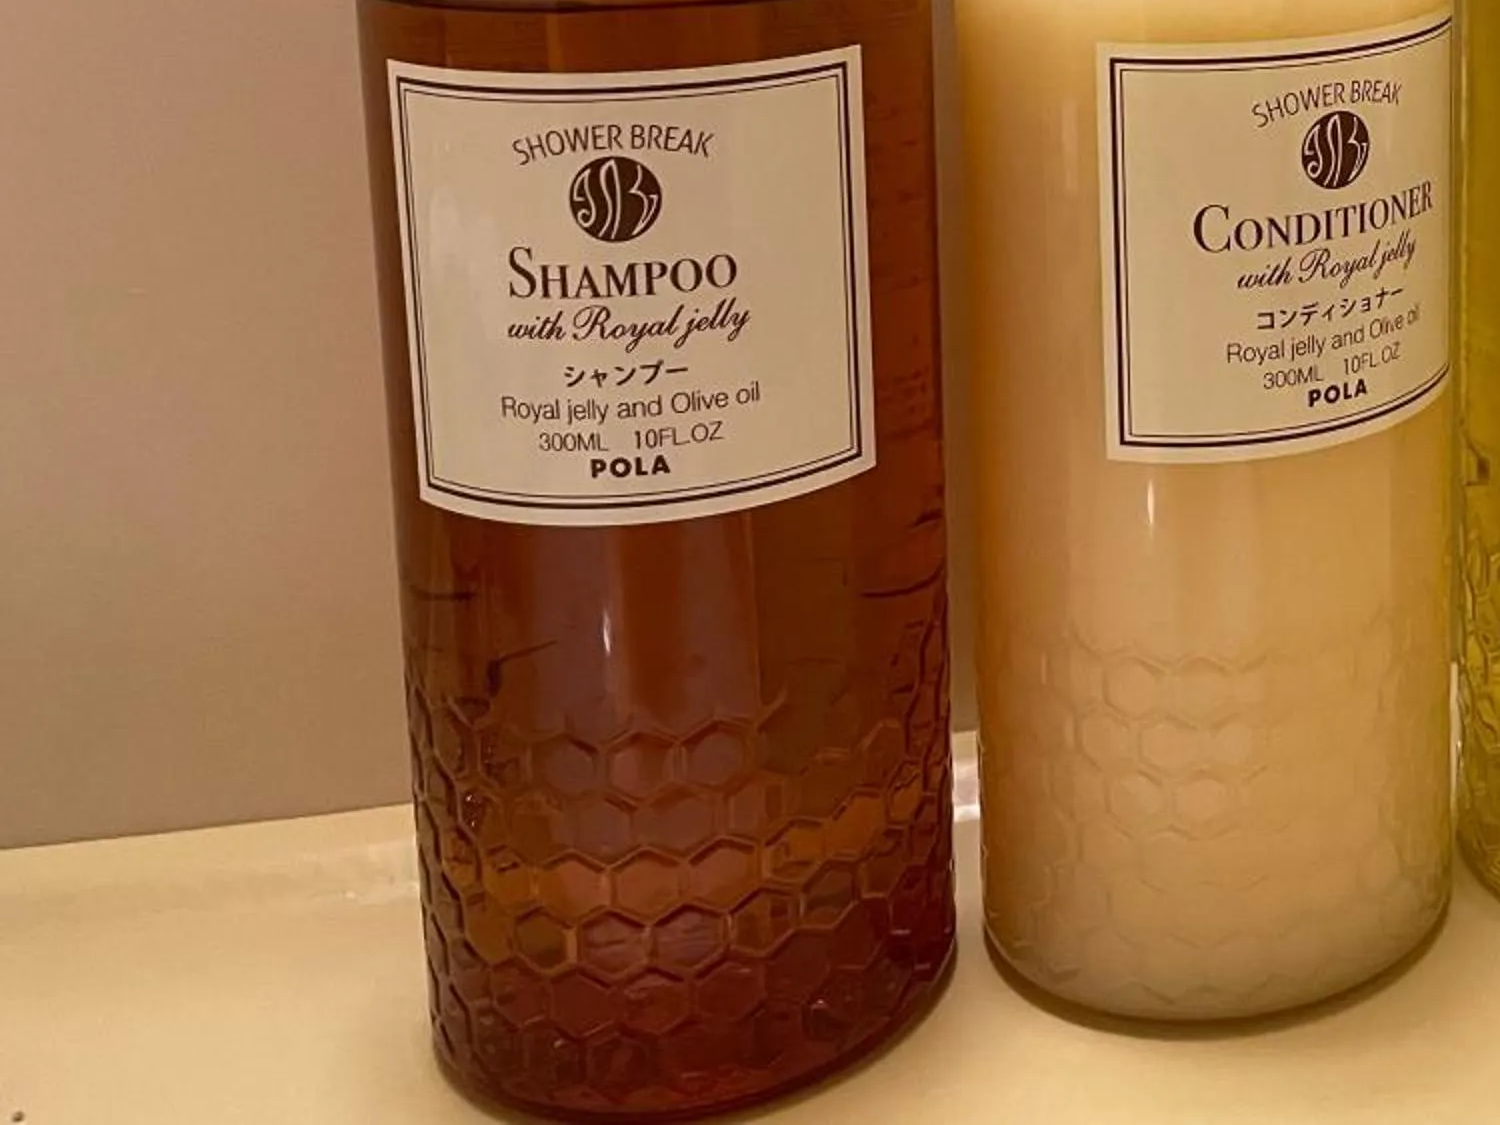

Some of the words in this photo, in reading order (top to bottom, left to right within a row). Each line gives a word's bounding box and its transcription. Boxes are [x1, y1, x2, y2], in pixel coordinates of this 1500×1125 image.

[1251, 81, 1345, 128] SHOWER
[1350, 80, 1402, 106] BREAK
[512, 124, 623, 165] SHOWER
[631, 124, 714, 158] BREAK
[1193, 181, 1433, 253] CONDITIONER
[509, 246, 737, 300] SHAMPOO
[1237, 260, 1294, 290] with
[1299, 244, 1378, 289] Royal
[1374, 229, 1417, 279] jelly
[507, 312, 566, 341] with
[572, 305, 680, 353] Royal
[674, 298, 750, 349] jelly
[1257, 287, 1403, 330] コンディショナー
[1227, 338, 1285, 365] Royal
[1290, 336, 1325, 361] jelly
[1331, 328, 1365, 350] and
[1369, 313, 1403, 339] Olive
[564, 359, 688, 387] シャンプー
[1263, 364, 1324, 390] 300ML
[1308, 378, 1367, 407] POLA
[501, 396, 560, 424] Royal
[568, 399, 609, 425] jelly
[617, 395, 663, 419] and
[671, 390, 729, 414] Olive
[736, 381, 761, 405] oil
[539, 432, 609, 452] 300ML
[590, 455, 670, 478] POLA
